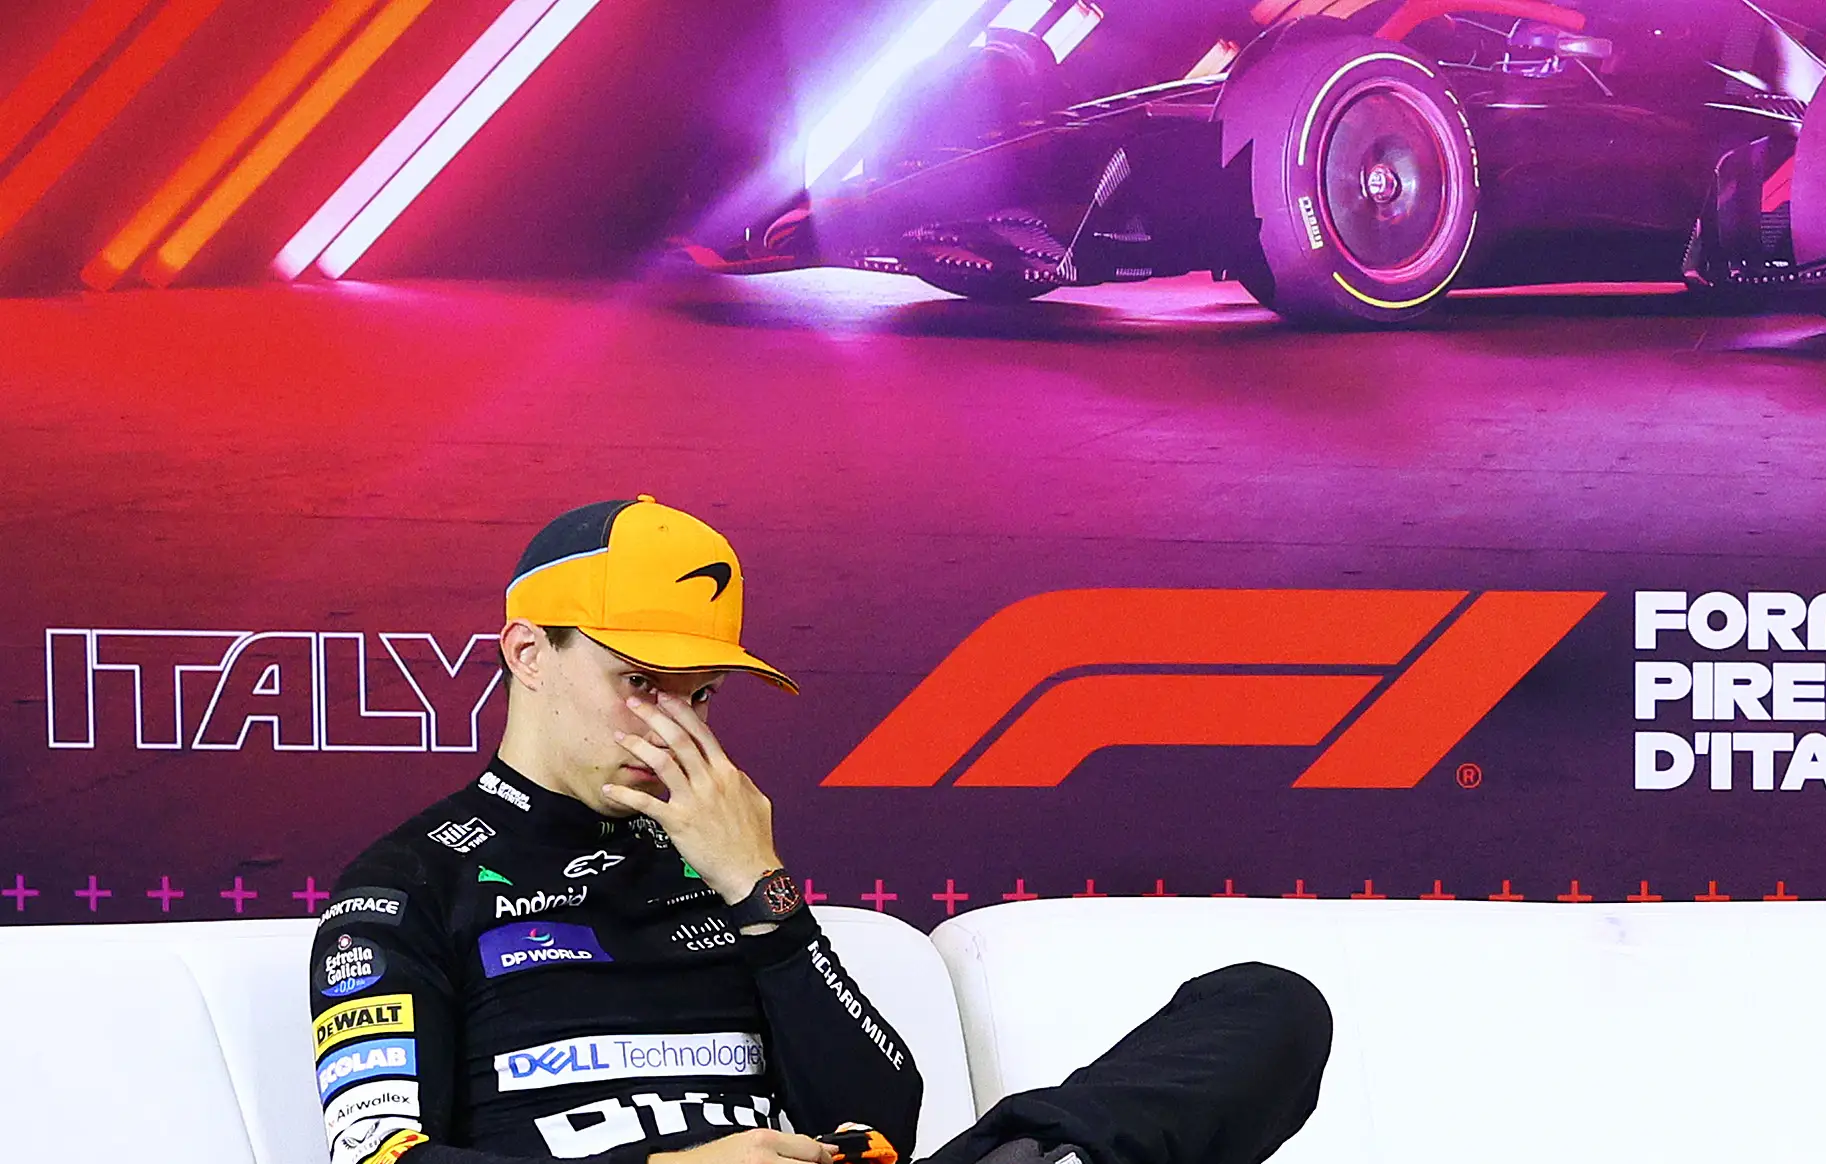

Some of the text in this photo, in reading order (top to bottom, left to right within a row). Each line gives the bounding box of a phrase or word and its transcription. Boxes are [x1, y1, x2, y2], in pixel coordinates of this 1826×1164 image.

[45, 628, 500, 752] ITALY
[495, 886, 588, 919] Android
[325, 946, 373, 972] Estrella
[327, 961, 373, 986] Galicia
[500, 948, 593, 968] DP WORLD
[807, 939, 905, 1071] RICHARD MILLE
[507, 1037, 766, 1079] DELL Technologie
[336, 1092, 412, 1123] Airwallex
